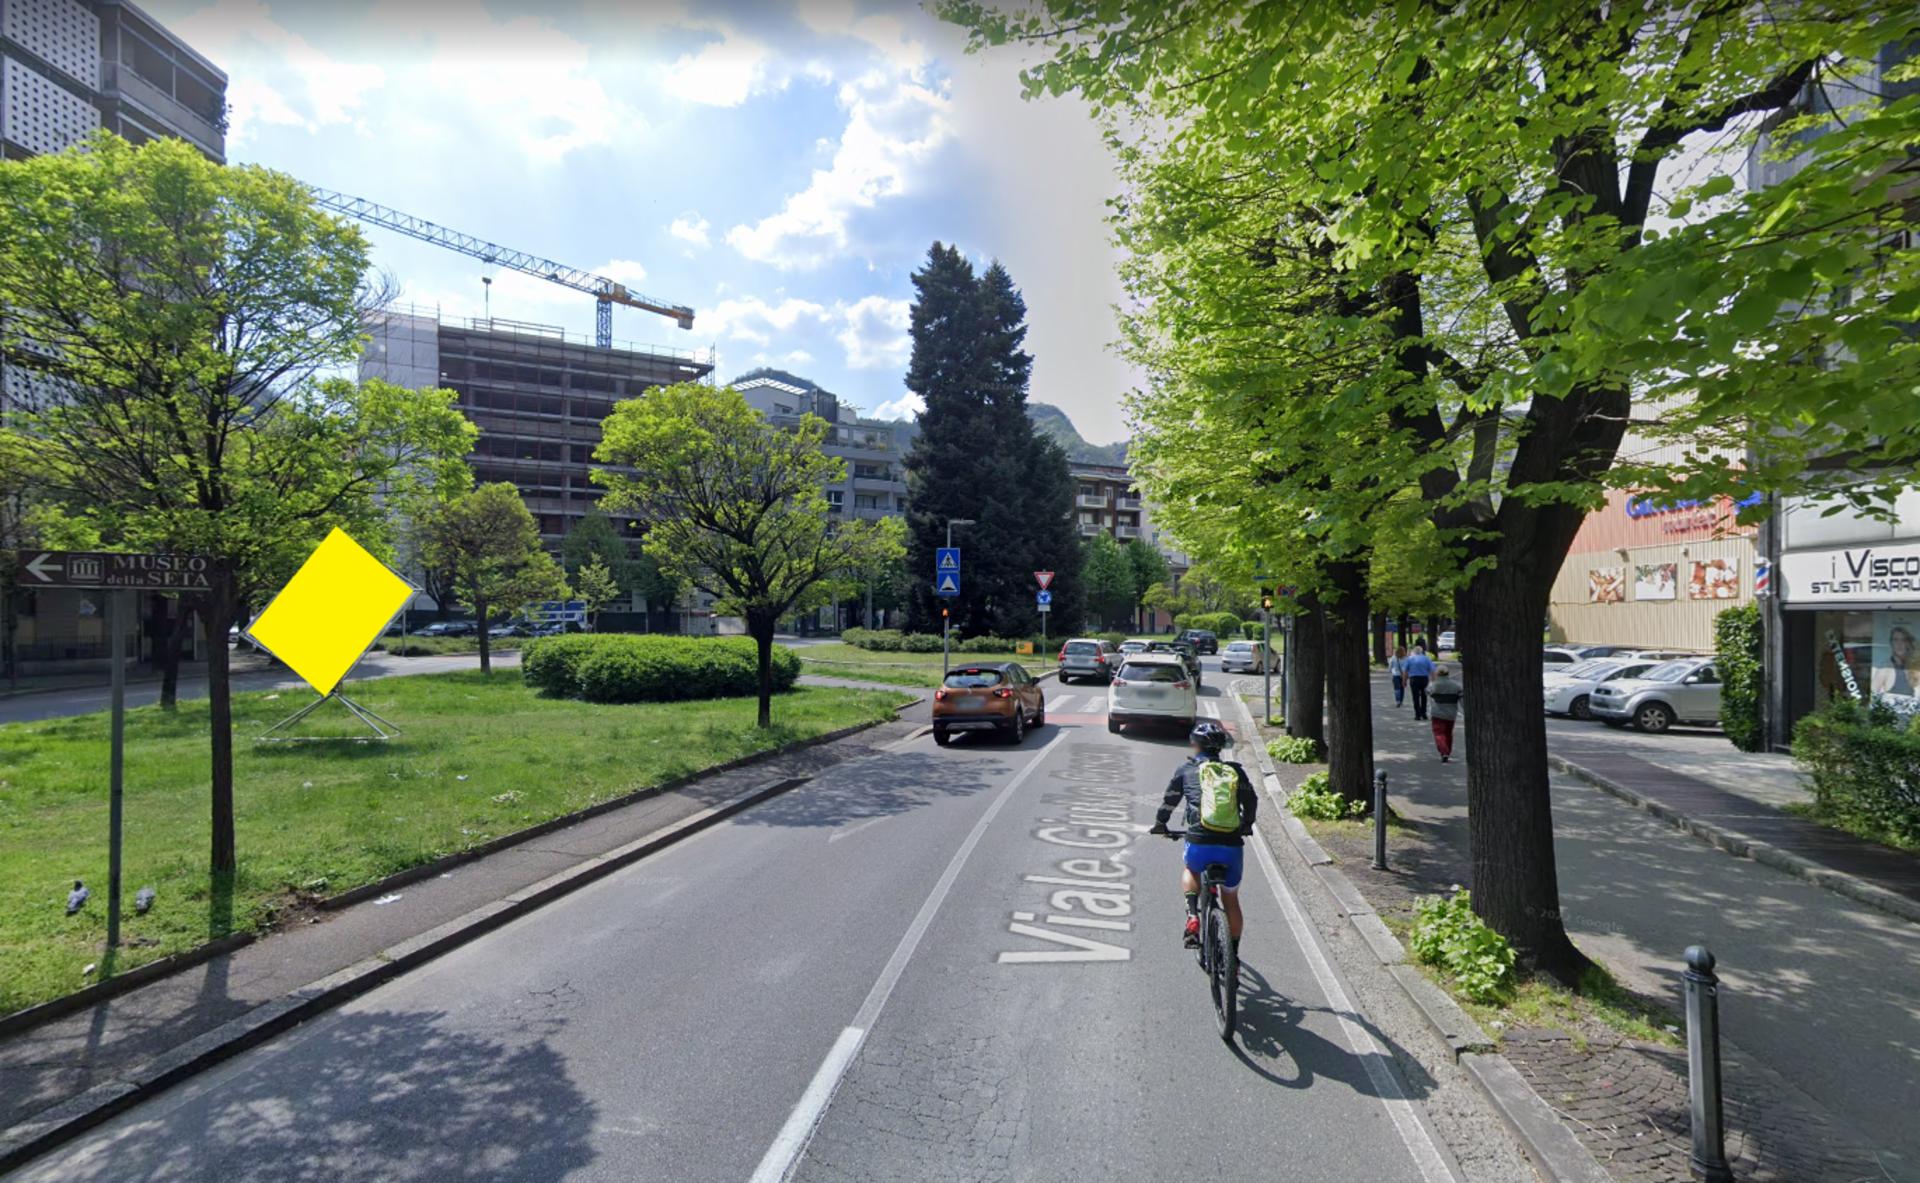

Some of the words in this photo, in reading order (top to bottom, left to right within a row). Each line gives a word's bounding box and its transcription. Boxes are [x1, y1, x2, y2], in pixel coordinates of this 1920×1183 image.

[113, 555, 207, 571] MUSEO
[106, 573, 144, 586] della
[147, 571, 209, 587] SETA
